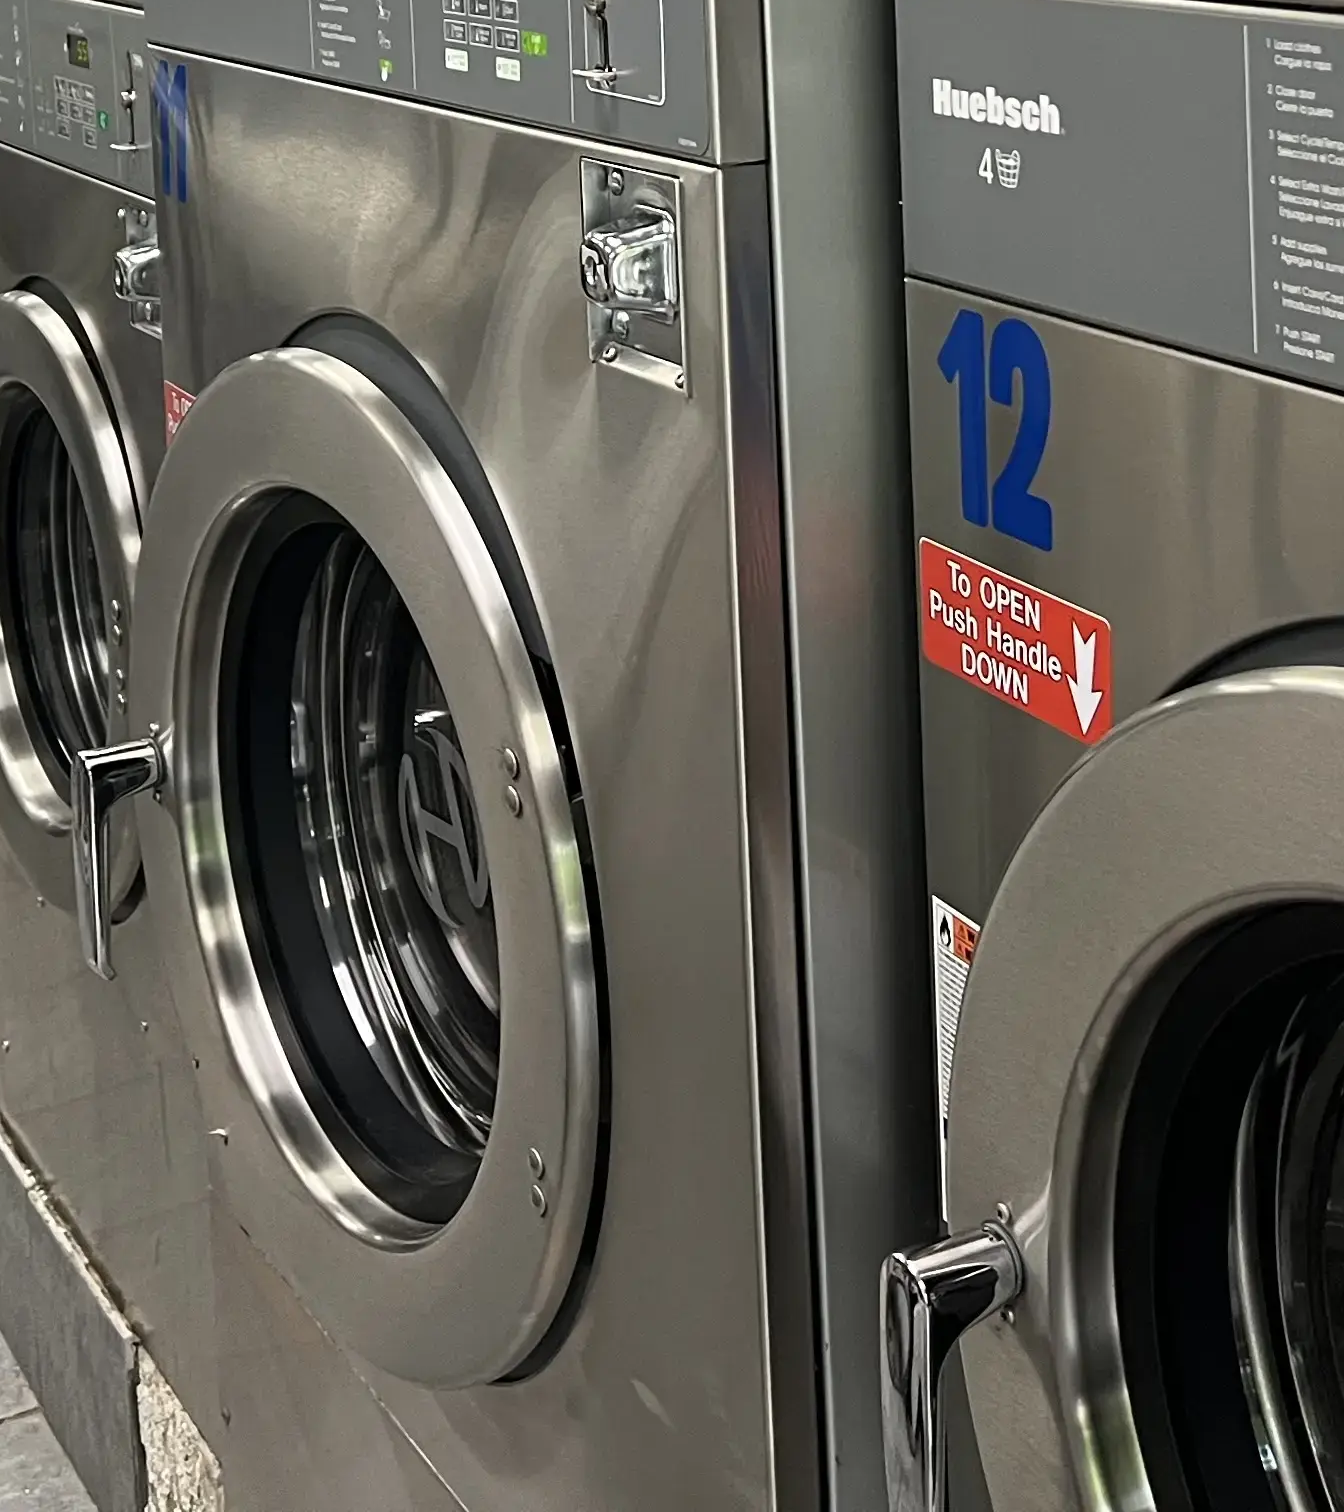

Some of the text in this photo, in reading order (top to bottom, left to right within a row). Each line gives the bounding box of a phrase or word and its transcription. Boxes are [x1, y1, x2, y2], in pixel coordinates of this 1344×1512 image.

[932, 78, 1061, 135] Huebsch
[978, 147, 994, 185] 4
[937, 309, 1053, 552] 12
[947, 560, 1041, 633] To OPEN
[929, 590, 1063, 682] Push Handle
[961, 643, 1029, 706] DOWN
